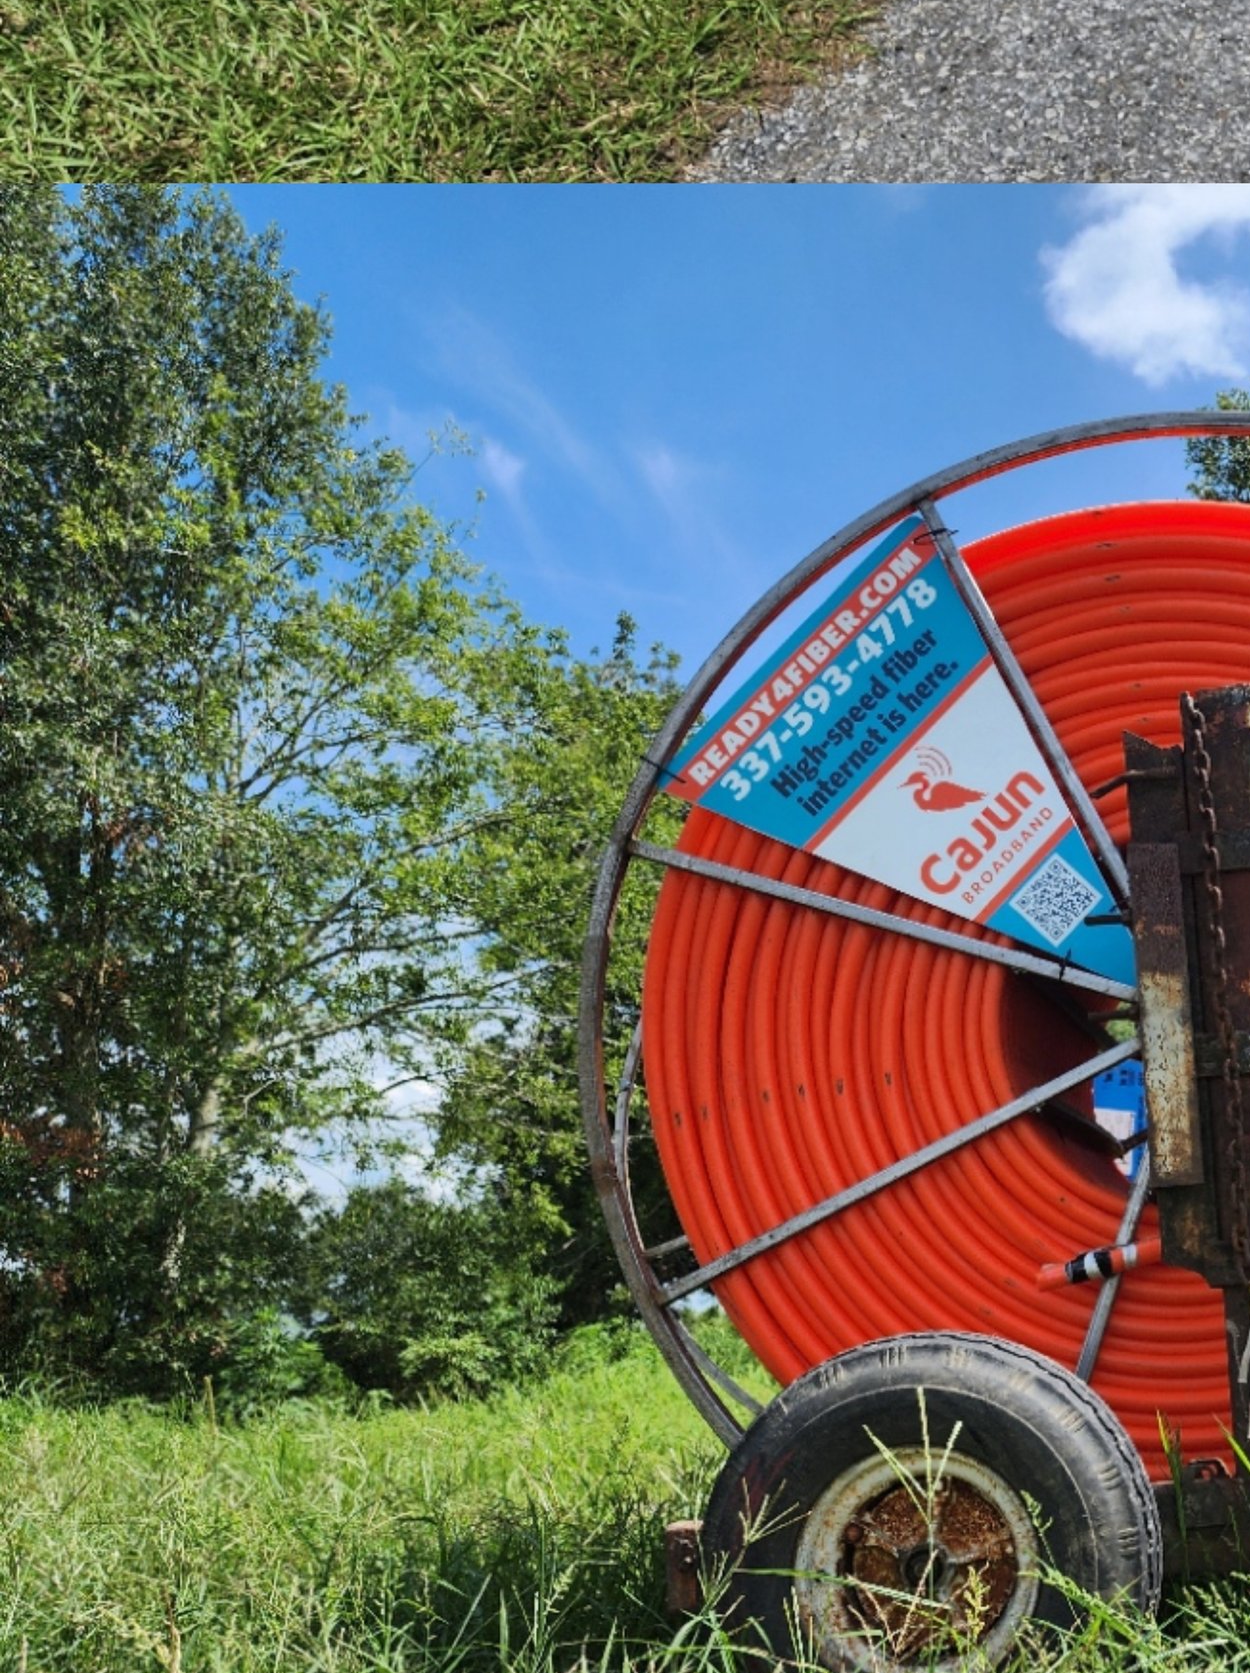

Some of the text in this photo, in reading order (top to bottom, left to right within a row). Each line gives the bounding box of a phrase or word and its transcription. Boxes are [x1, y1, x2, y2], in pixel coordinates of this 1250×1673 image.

[688, 546, 921, 786] READY4FIBER.COM
[720, 578, 936, 801] 337-593-4778
[771, 629, 936, 799] High-speed fiber
[798, 661, 959, 817] internet is here.
[962, 806, 1053, 904] BROADBAND
